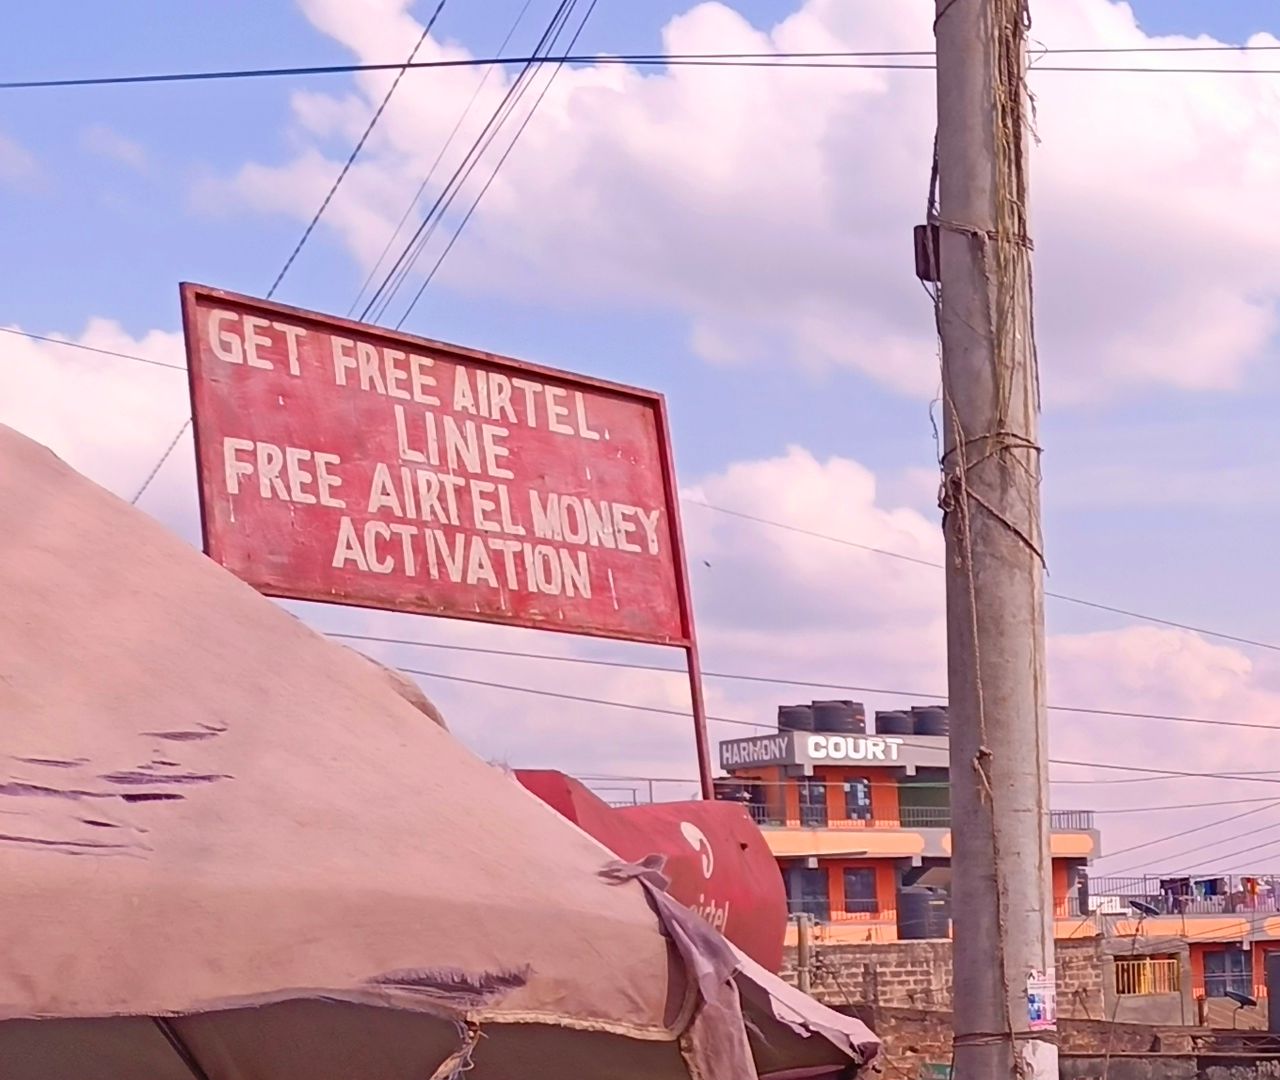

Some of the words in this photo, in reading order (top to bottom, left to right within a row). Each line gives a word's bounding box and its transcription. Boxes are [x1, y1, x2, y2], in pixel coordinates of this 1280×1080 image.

[208, 309, 307, 376] GET
[330, 335, 441, 407] FREE
[393, 404, 515, 480] LINE
[223, 436, 348, 510] FREE
[367, 462, 526, 537] AIRTEL
[528, 488, 661, 556] MONEY
[331, 516, 592, 600] ACTIVATION
[722, 736, 788, 765] HARMONY
[807, 735, 904, 761] COURT
